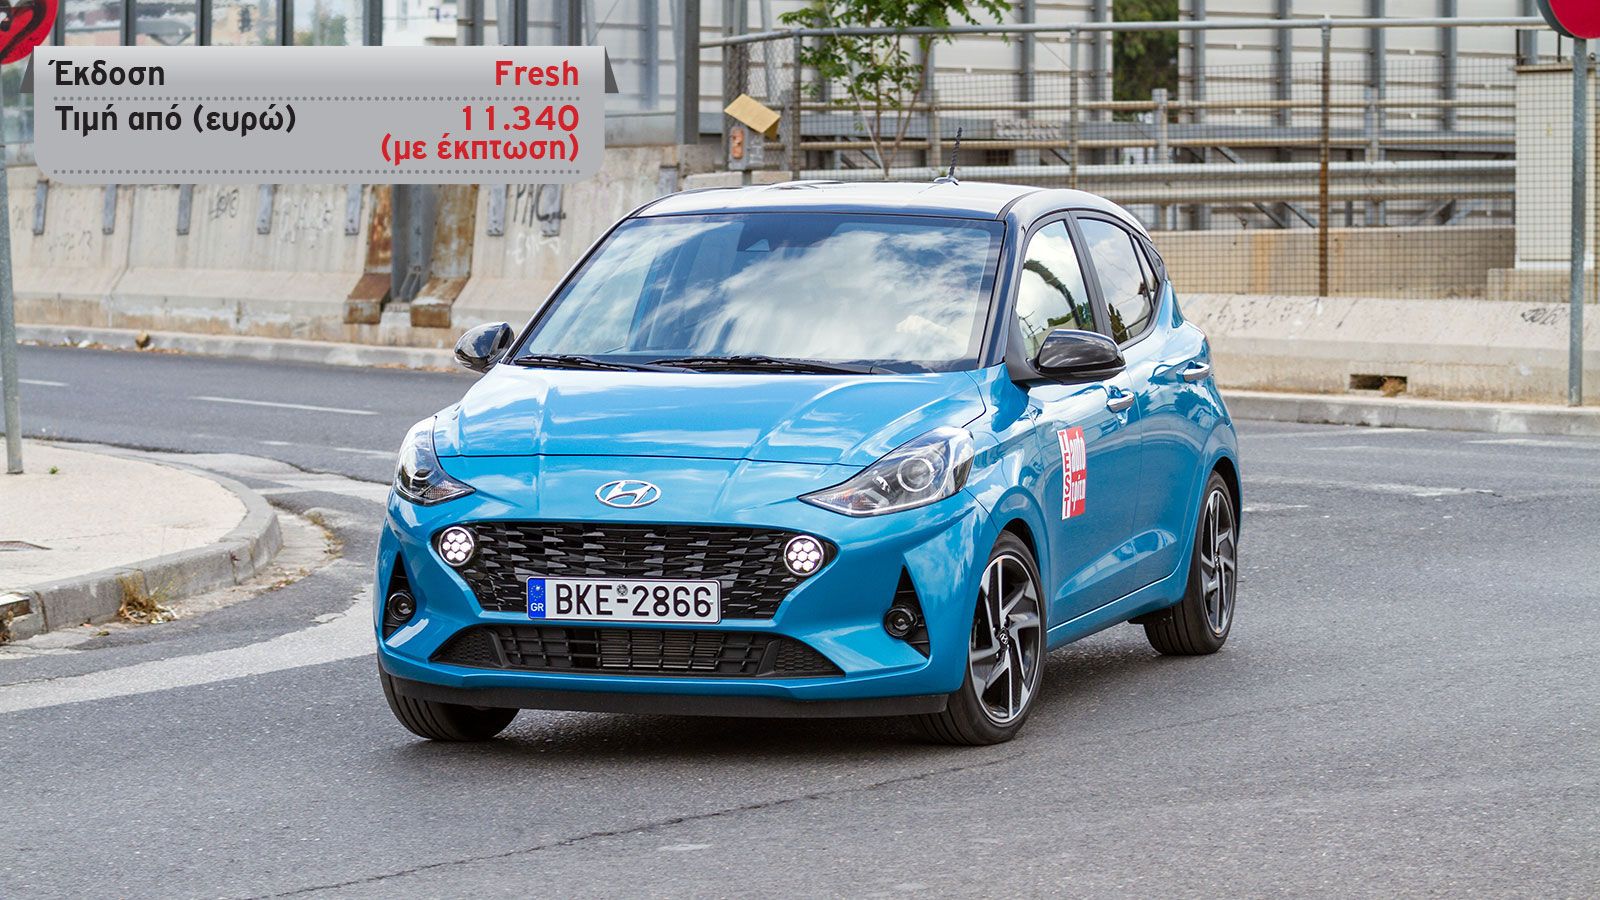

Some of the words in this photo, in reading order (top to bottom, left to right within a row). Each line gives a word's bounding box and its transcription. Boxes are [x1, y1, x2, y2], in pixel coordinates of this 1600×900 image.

[1059, 431, 1071, 517] TEST
[530, 603, 544, 612] GR
[556, 584, 711, 617] BKE-2866
